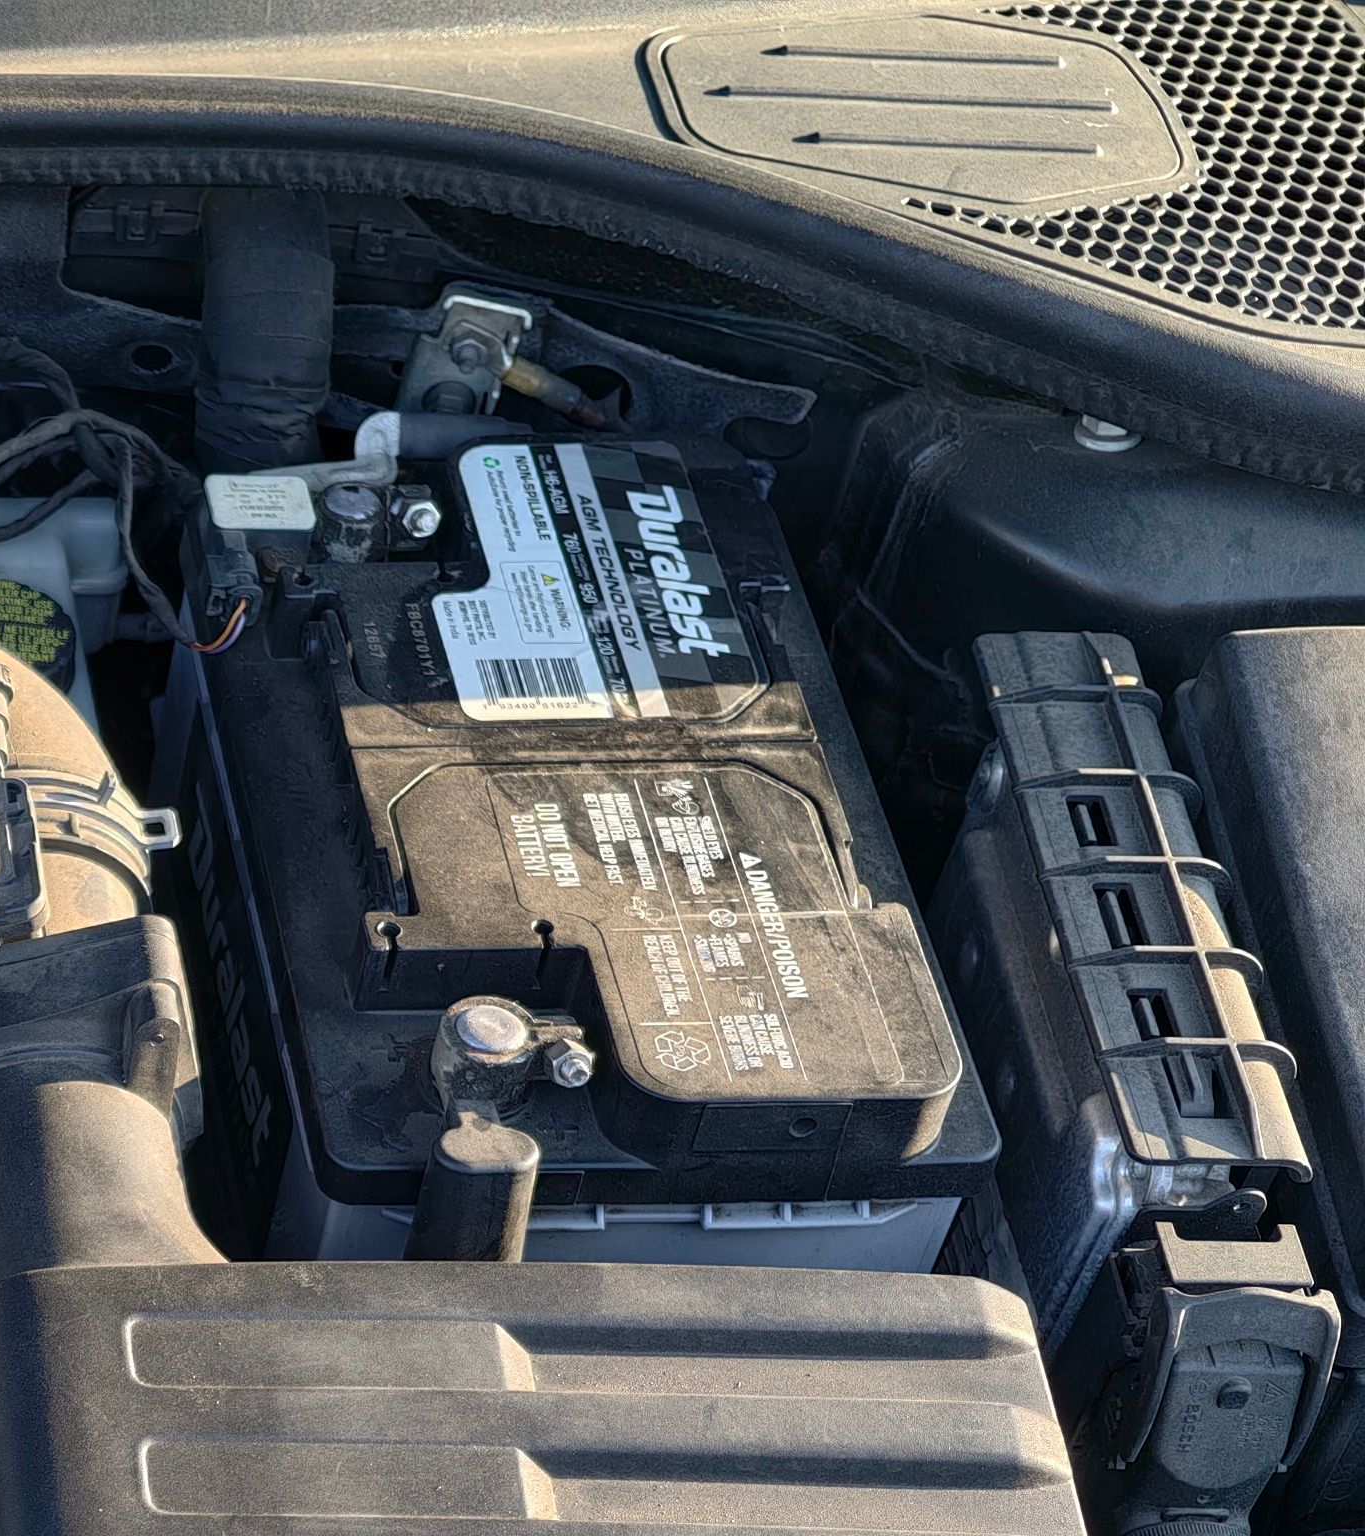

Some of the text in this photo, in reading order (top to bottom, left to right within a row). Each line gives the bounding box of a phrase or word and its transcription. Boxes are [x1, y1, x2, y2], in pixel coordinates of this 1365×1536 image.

[513, 456, 552, 540] NON-SPILLABLE
[561, 532, 582, 553] 760
[577, 583, 599, 603] 950
[594, 636, 615, 655] 120
[576, 494, 602, 530] AGM
[590, 538, 641, 651] TECHNOLOGY
[623, 485, 731, 657] Duralast
[508, 815, 550, 876] BATTERY!
[532, 803, 582, 886] DO NOT OPEN
[598, 844, 617, 863] HELP
[658, 934, 678, 955] KEEP
[664, 956, 684, 972] OUT
[744, 870, 808, 997] DANGER/POISON
[673, 985, 693, 1001] THE
